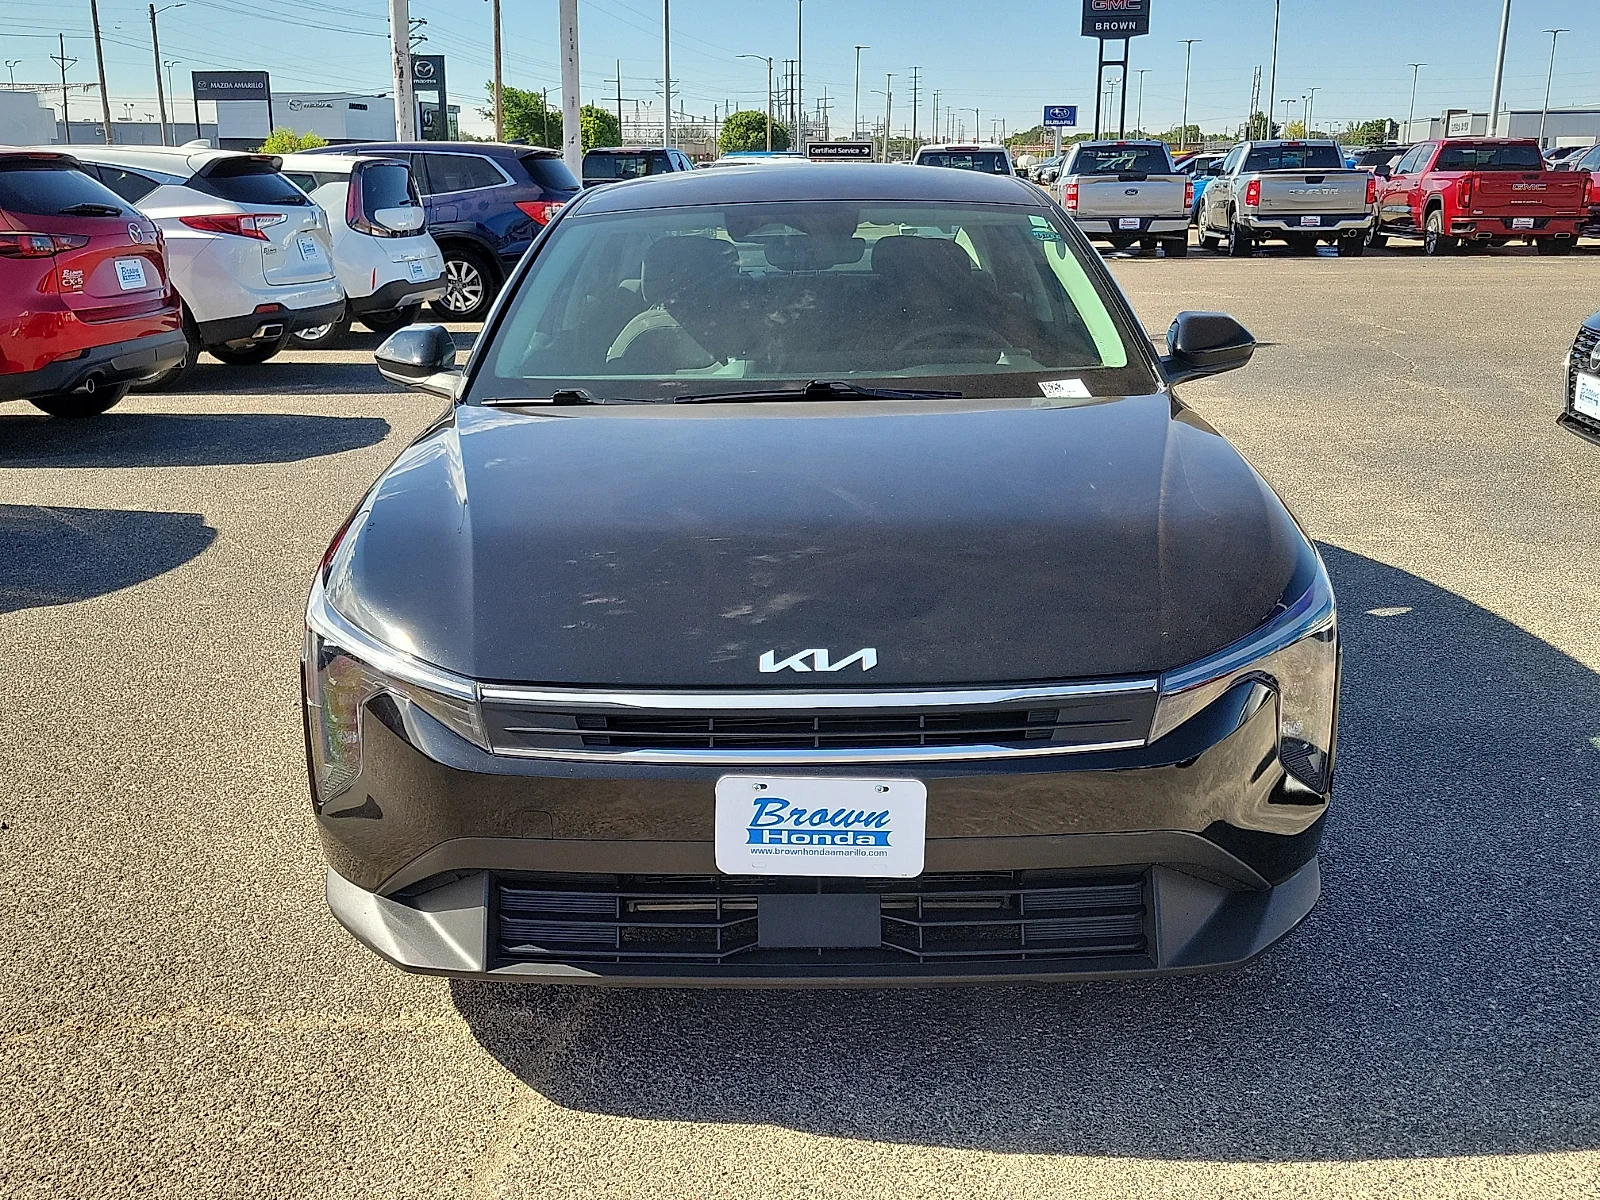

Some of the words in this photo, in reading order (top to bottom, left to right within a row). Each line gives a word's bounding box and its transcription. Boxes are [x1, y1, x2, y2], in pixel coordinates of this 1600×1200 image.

[1092, 0, 1141, 10] GMC
[1095, 22, 1136, 30] BROWN
[1512, 183, 1547, 191] GMC
[759, 648, 878, 673] KIA
[749, 797, 892, 829] Brown
[762, 829, 876, 845] Honda
[750, 847, 888, 857] www.brownhondaamarillo.com
